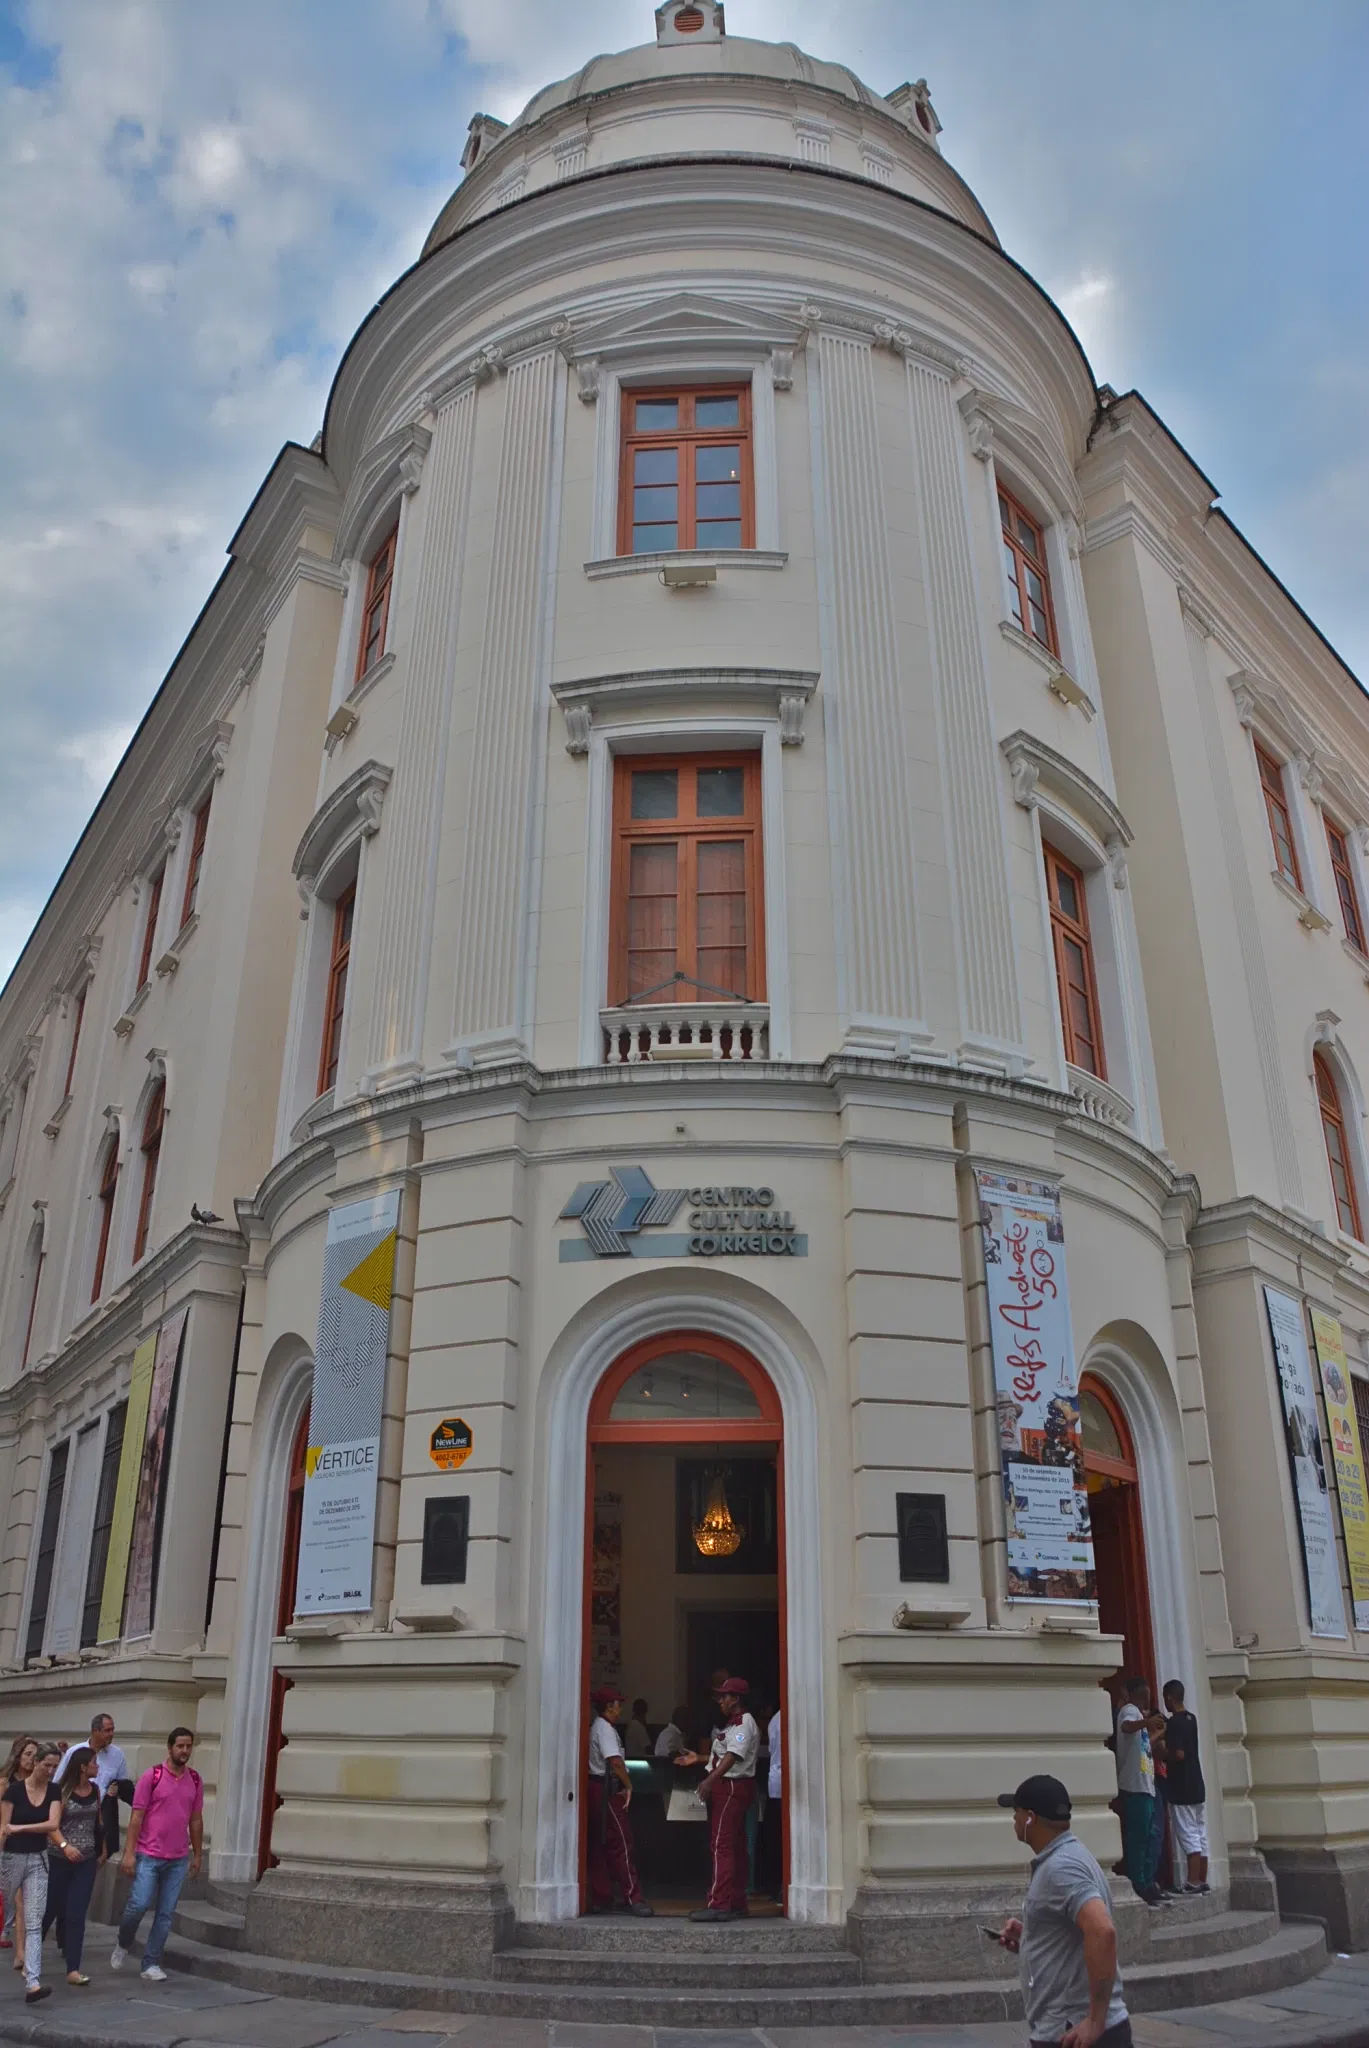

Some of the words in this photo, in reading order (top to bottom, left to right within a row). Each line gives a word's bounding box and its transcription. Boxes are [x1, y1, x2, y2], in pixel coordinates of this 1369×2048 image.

[687, 1187, 774, 1207] CENTRO
[688, 1210, 796, 1230] CULTURAL
[687, 1234, 798, 1255] CORREIOS
[1035, 1228, 1048, 1273] ANOS
[315, 1446, 374, 1471] VÉRTICE
